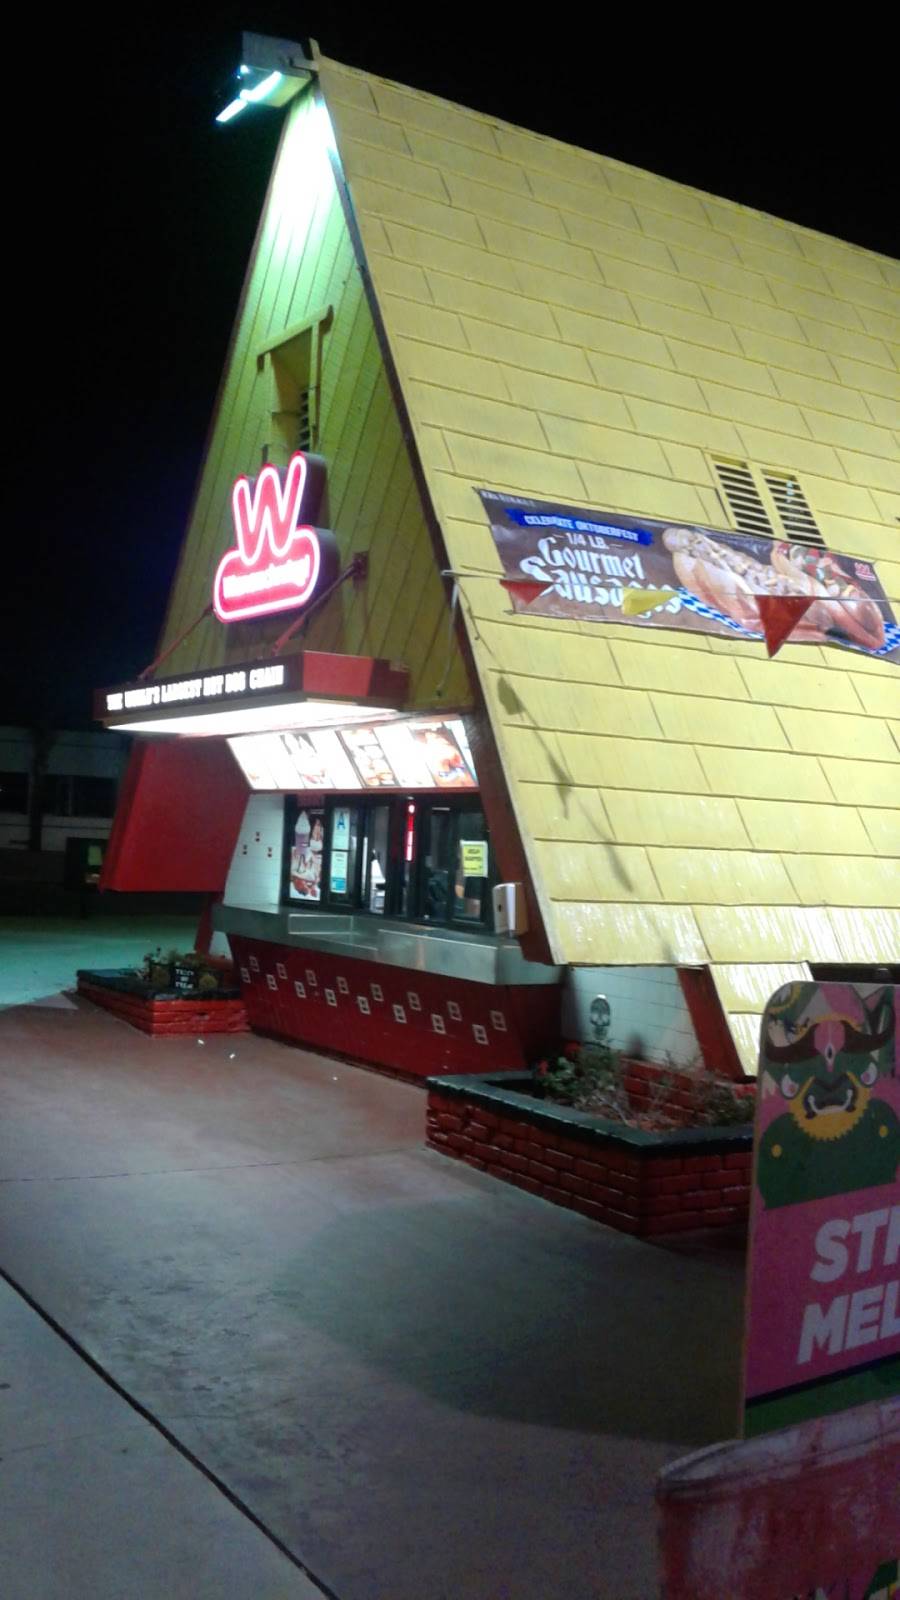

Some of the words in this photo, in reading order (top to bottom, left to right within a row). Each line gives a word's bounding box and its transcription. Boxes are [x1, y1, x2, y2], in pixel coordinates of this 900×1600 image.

[566, 532, 586, 546] 1/4
[575, 520, 639, 541] OKTOBERFEST
[537, 536, 645, 580] Gourmet
